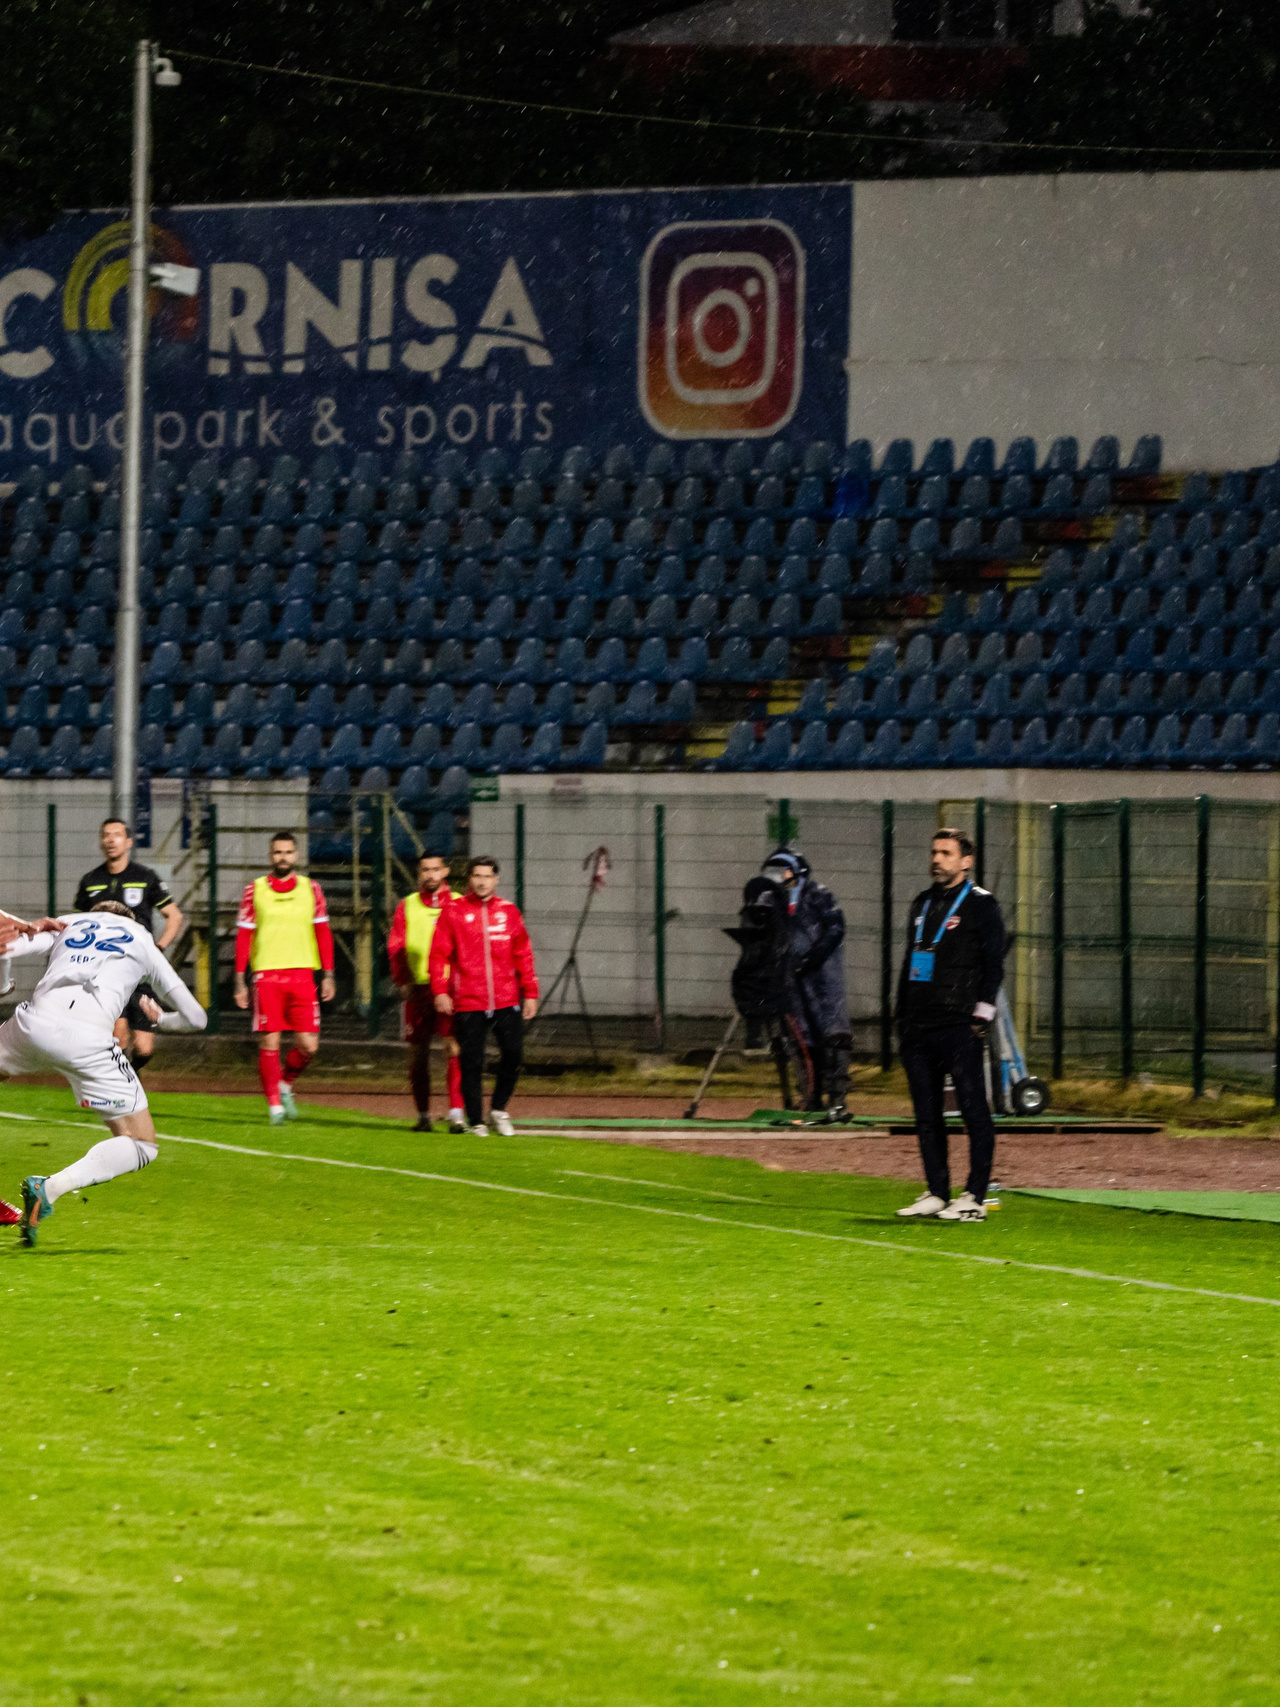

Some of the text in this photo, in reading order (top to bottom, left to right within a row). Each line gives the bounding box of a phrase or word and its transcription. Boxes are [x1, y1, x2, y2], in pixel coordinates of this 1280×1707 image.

[311, 398, 346, 446] &
[375, 391, 554, 455] sports
[64, 918, 134, 955] 32
